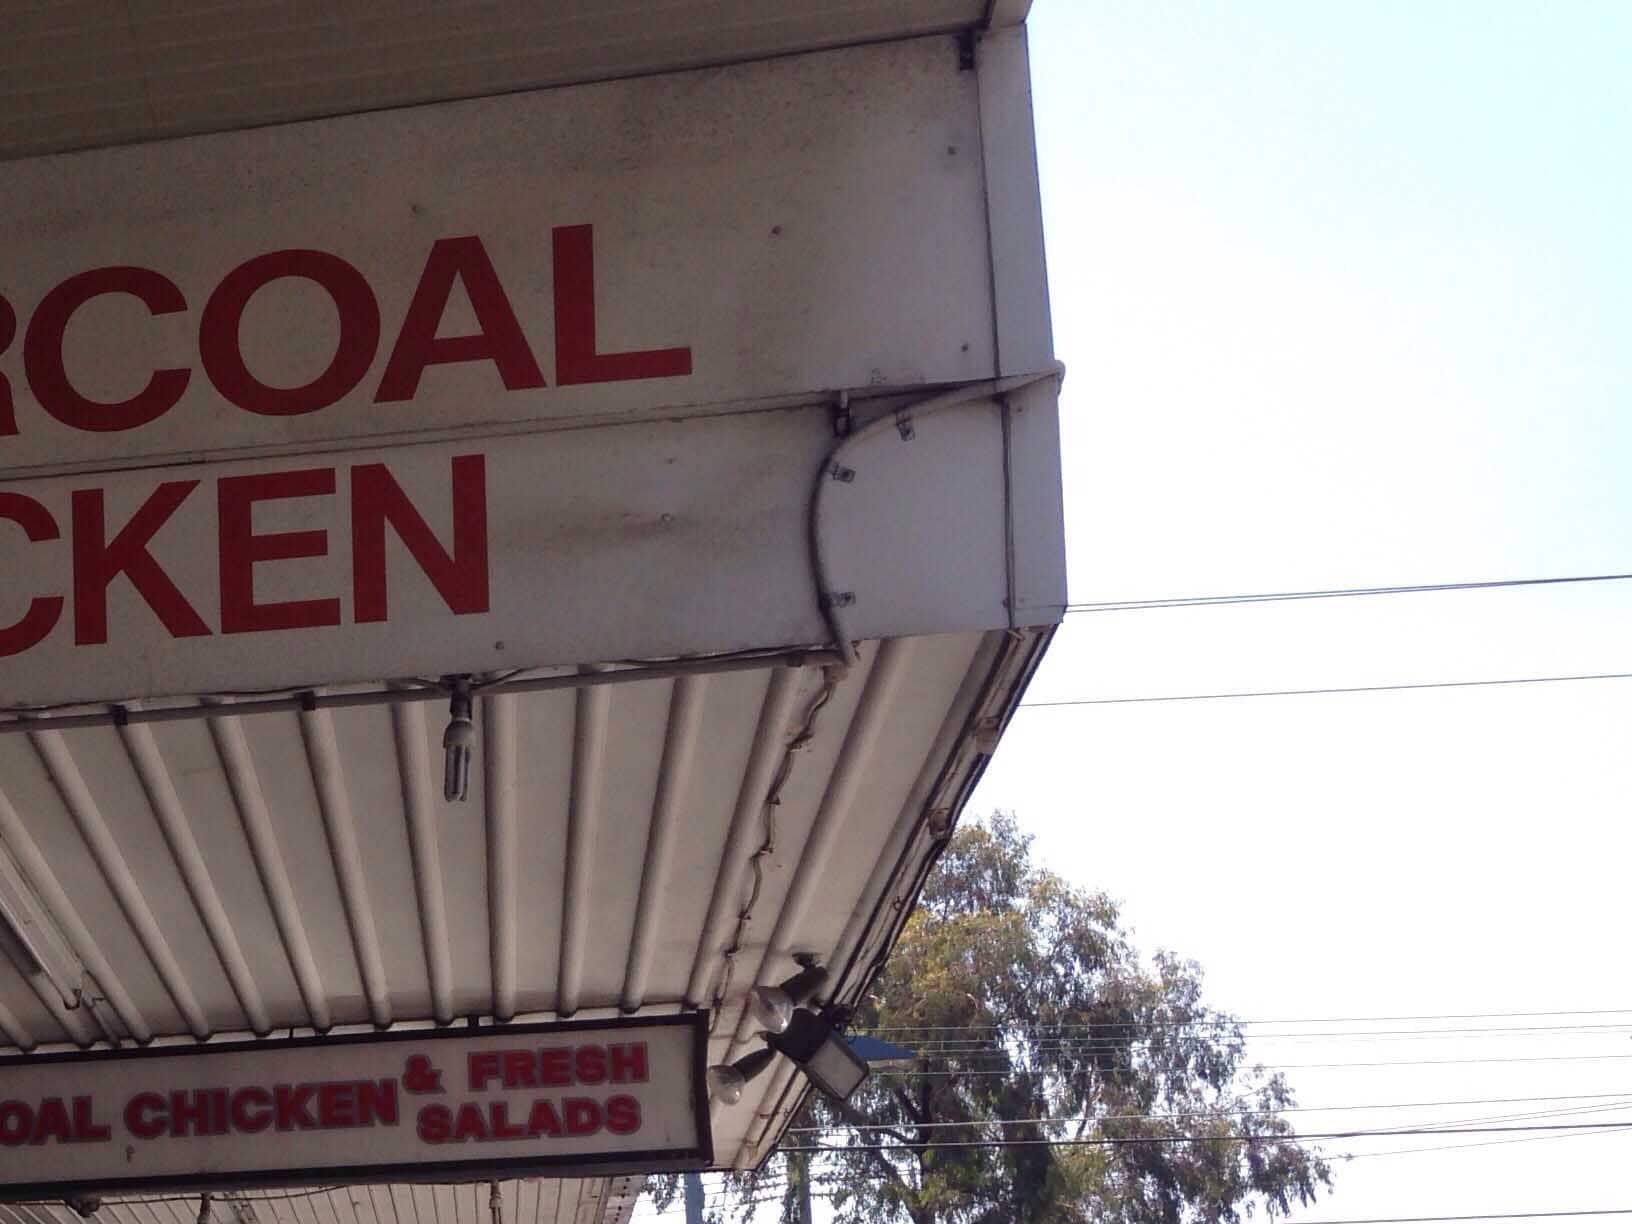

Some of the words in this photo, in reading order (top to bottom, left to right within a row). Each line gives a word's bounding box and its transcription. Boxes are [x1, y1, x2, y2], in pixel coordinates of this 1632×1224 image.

[402, 1053, 446, 1094] &
[467, 1041, 649, 1091] FRESH
[123, 1079, 399, 1140] CHICKEN
[416, 1093, 642, 1144] SALADS
